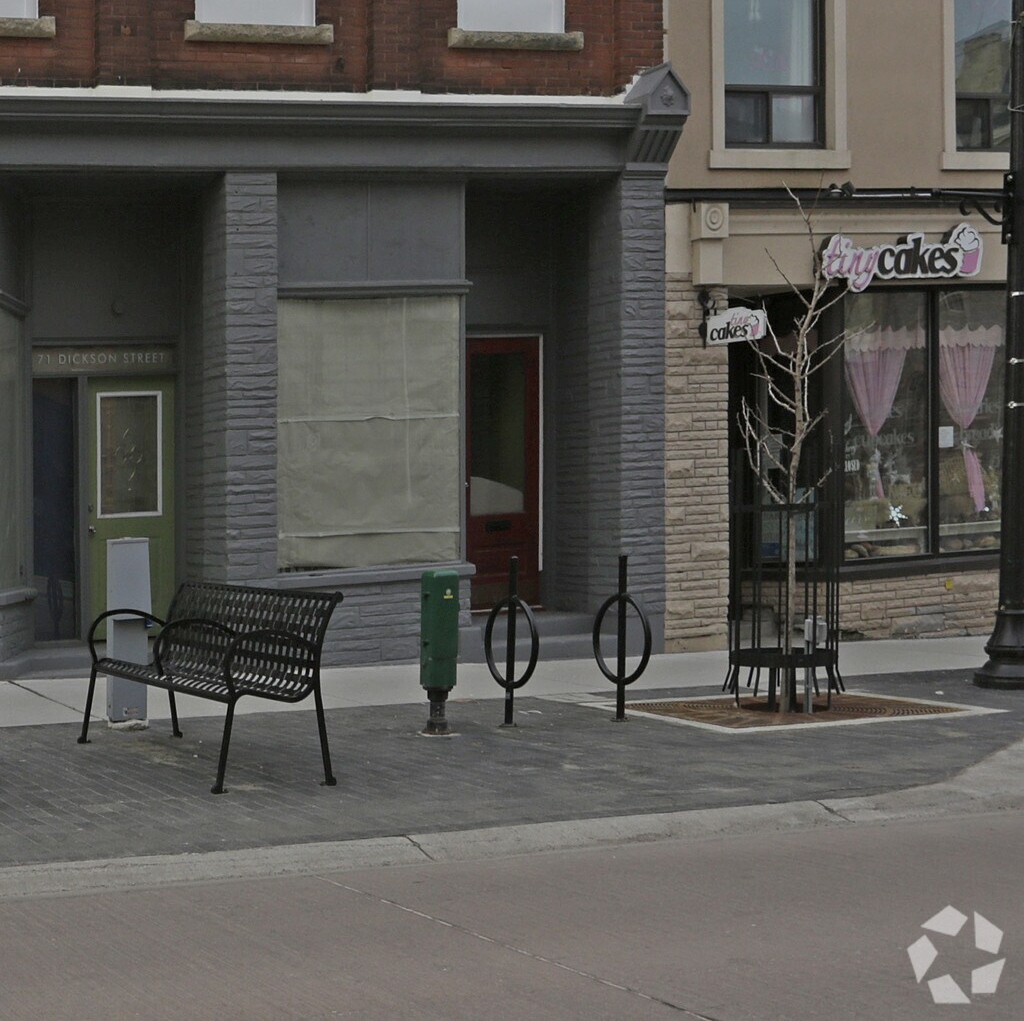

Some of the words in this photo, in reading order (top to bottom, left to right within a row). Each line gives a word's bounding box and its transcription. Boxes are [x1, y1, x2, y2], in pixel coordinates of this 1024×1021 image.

[710, 321, 749, 341] cakes
[38, 353, 51, 365] 71
[58, 353, 117, 365] DICKSON
[123, 352, 165, 364] STREET
